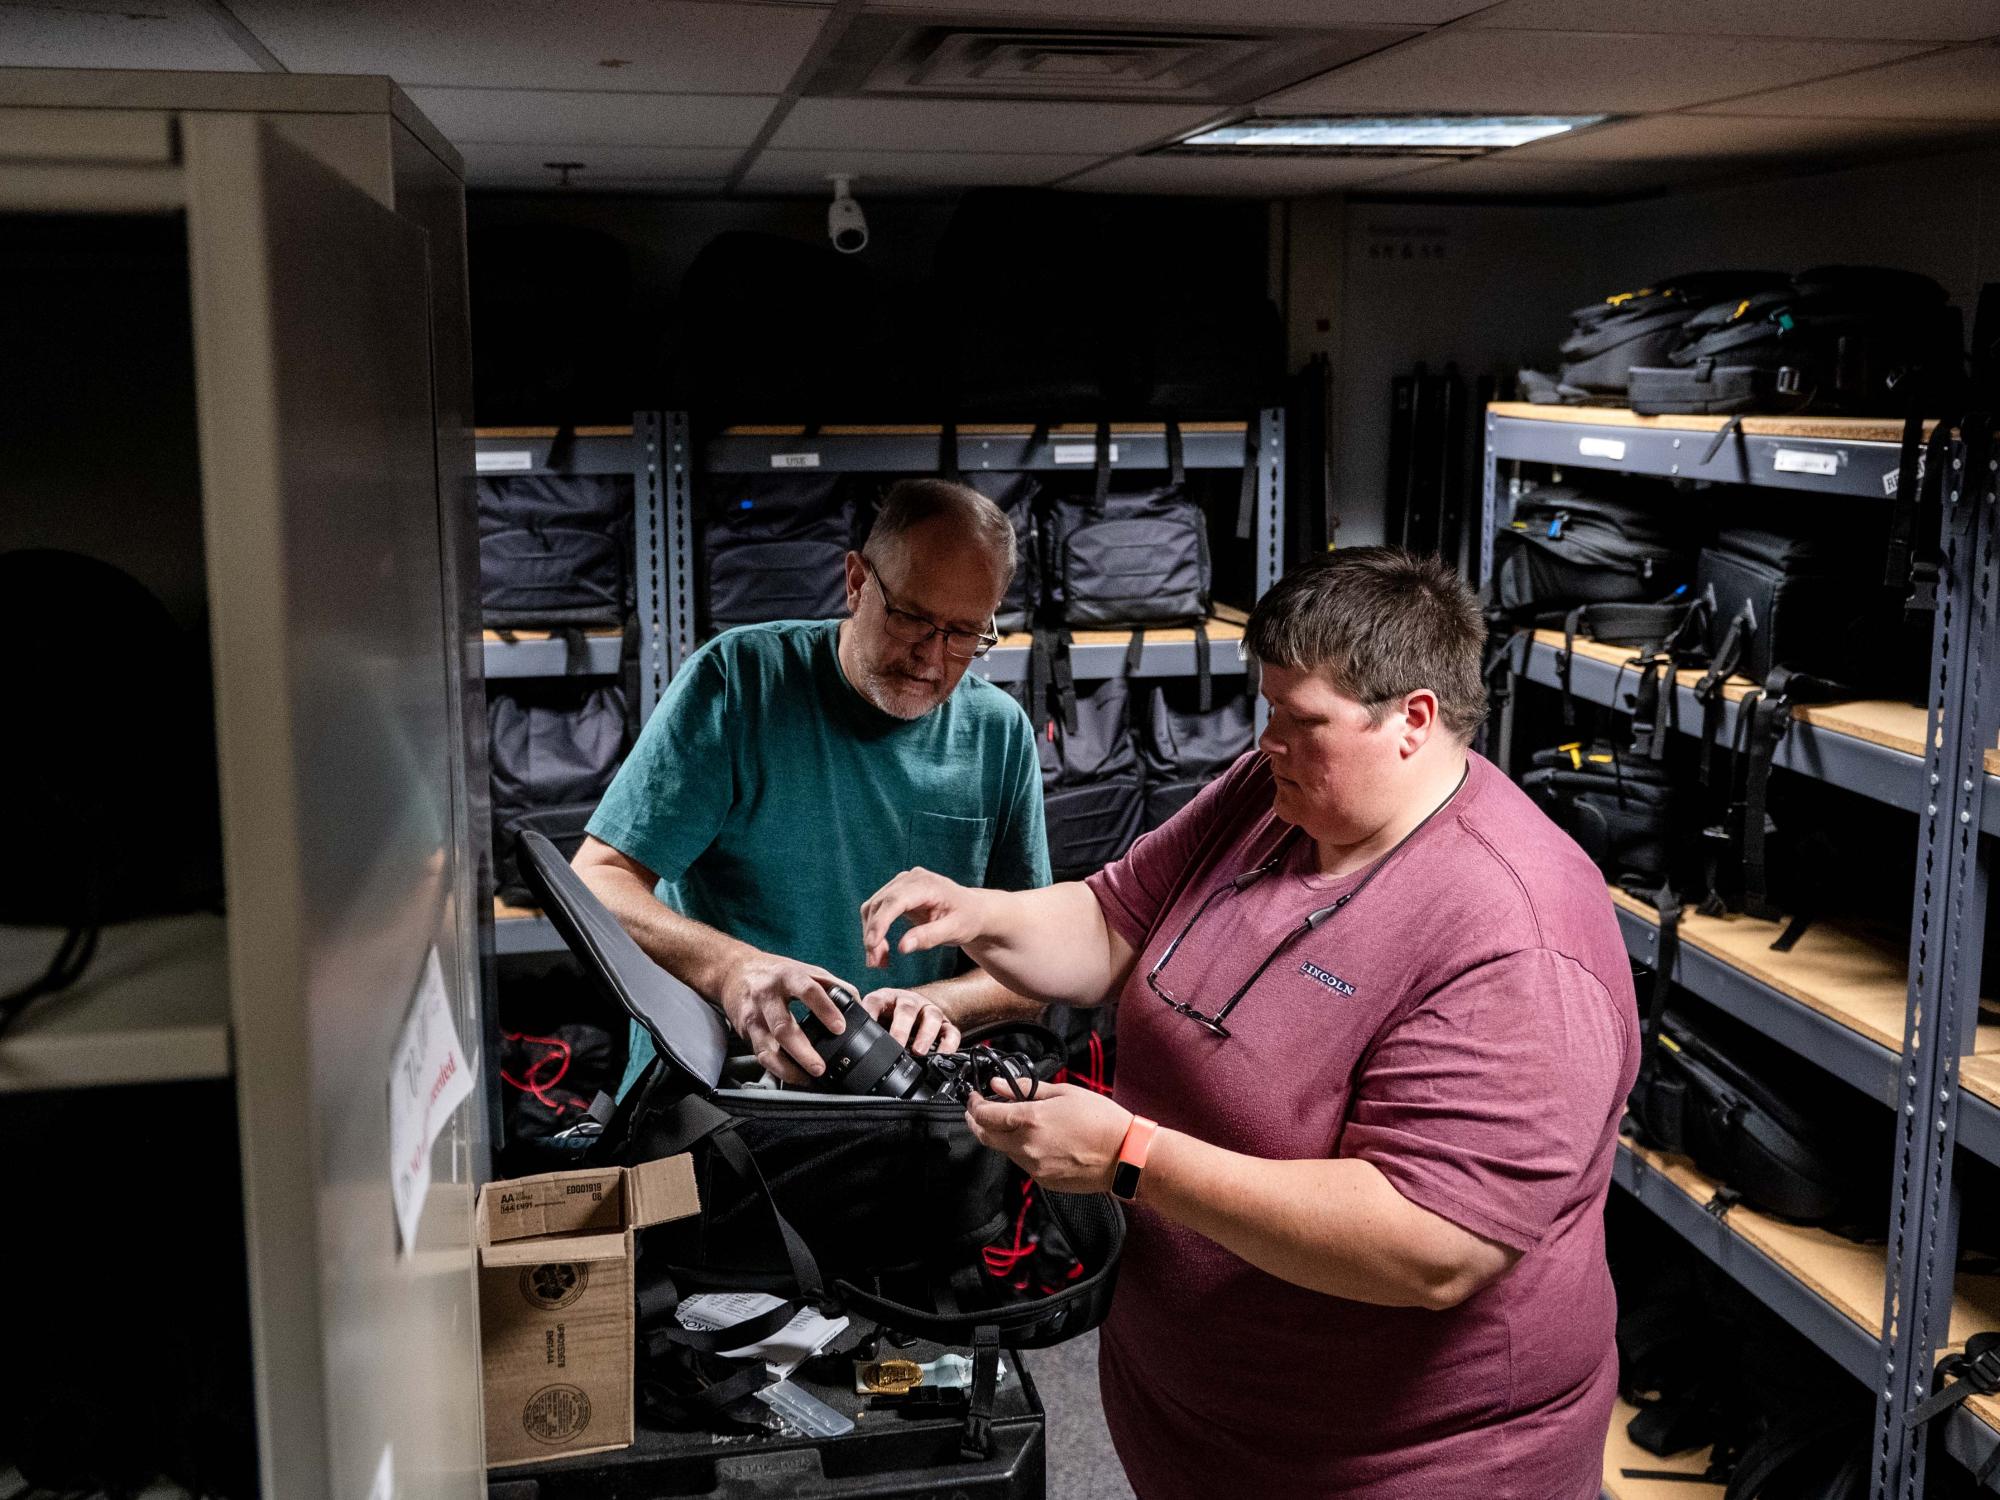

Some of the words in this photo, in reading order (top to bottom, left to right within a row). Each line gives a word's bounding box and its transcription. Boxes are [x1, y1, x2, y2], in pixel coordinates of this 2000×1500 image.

[1301, 962, 1355, 996] LINCOLN
[501, 1193, 514, 1203] AA
[501, 1204, 515, 1213] 144
